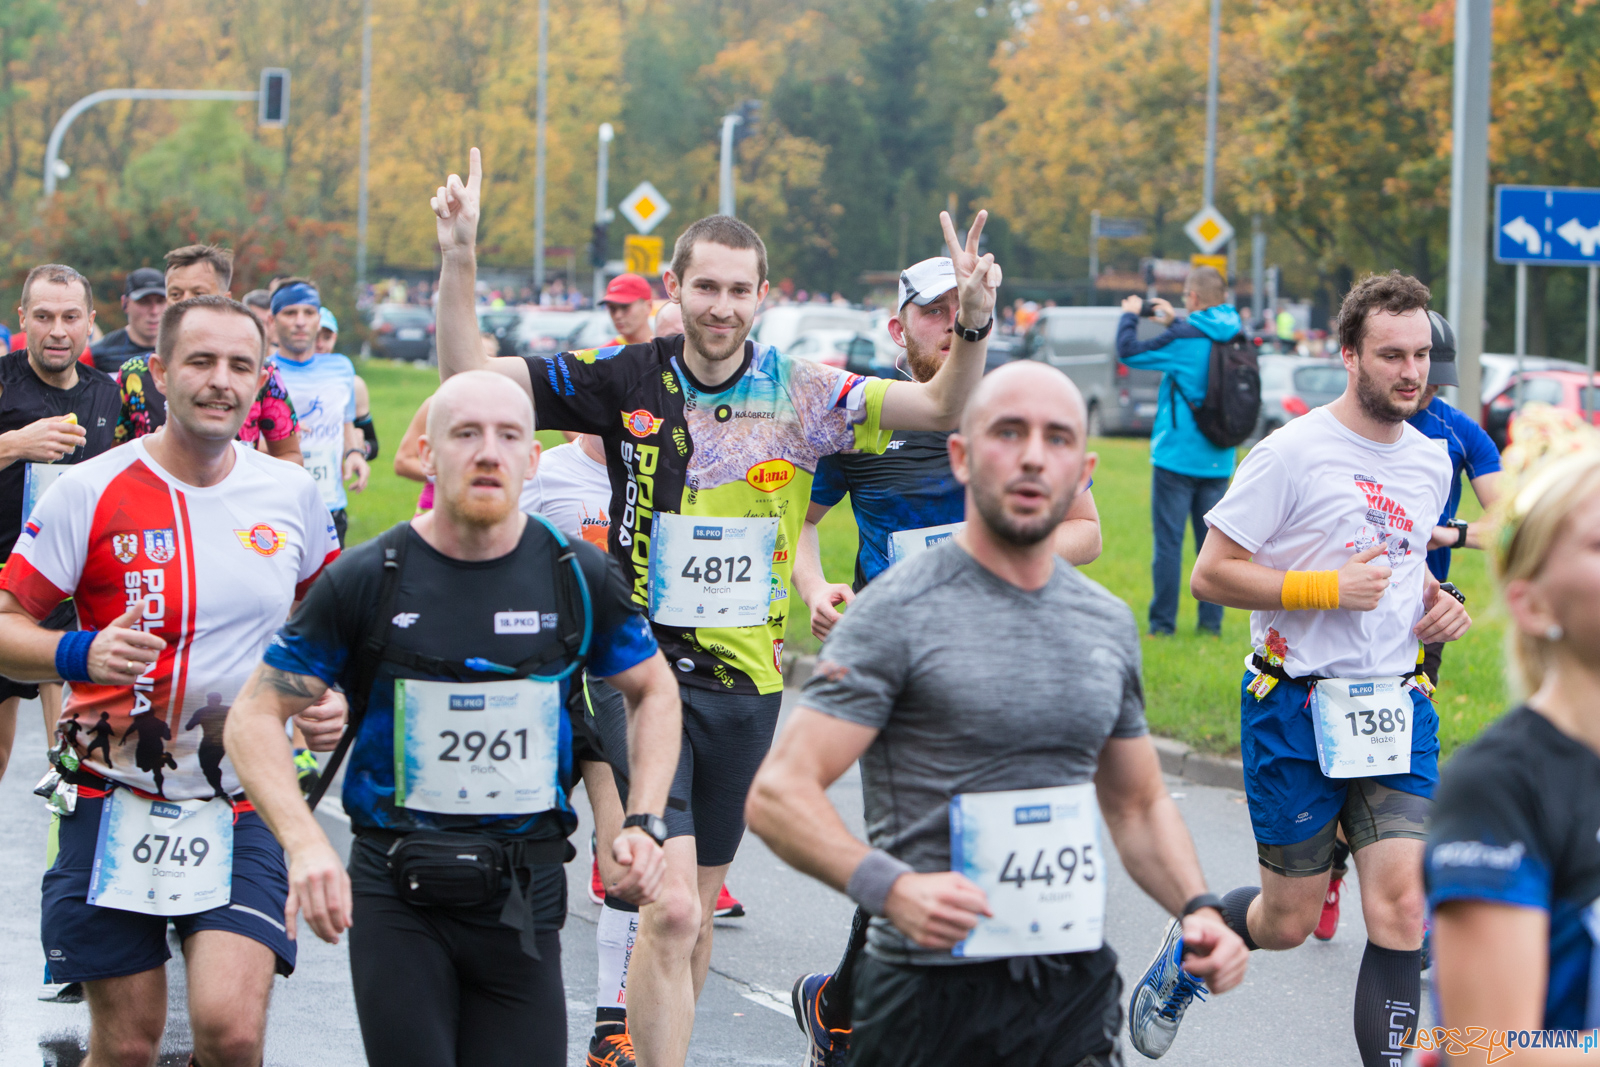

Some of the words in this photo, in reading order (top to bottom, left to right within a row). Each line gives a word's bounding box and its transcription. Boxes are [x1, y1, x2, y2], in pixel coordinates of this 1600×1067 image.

[752, 468, 789, 484] Jana
[1388, 514, 1414, 533] TOR
[706, 530, 721, 538] PKO
[681, 555, 752, 584] 4812
[702, 585, 732, 594] Marcin
[514, 617, 535, 626] PKO
[463, 698, 483, 707] PKO
[1345, 707, 1406, 736] 1389
[438, 728, 528, 762] 2961
[1370, 736, 1396, 744] Błażej
[470, 764, 496, 774] Piotr
[163, 807, 179, 816] PKO
[132, 833, 209, 867] 6749
[999, 844, 1096, 889] 4495
[151, 867, 186, 878] Damian
